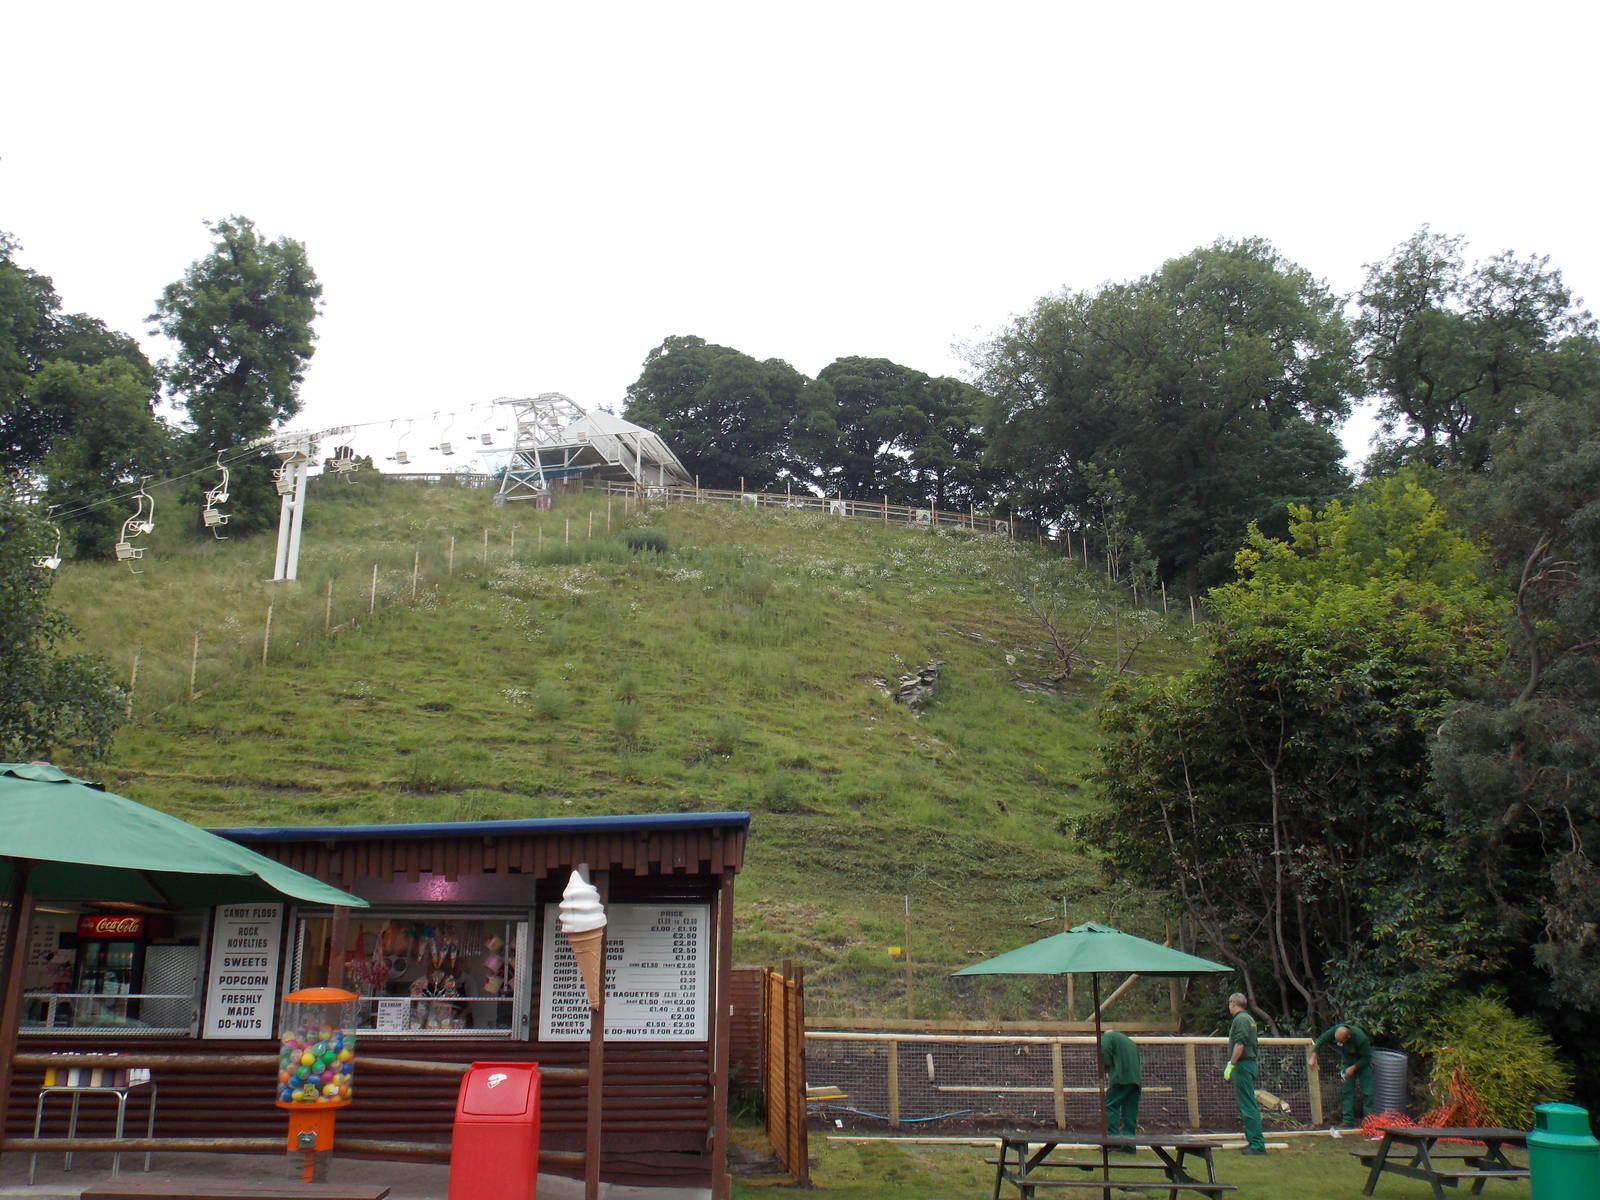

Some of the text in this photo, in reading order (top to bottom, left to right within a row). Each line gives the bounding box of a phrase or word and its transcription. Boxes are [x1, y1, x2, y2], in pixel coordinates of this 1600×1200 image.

[224, 908, 277, 917] CANDY FLOSS
[239, 928, 258, 936] ROCK
[227, 939, 267, 948] NOVELTIES
[224, 958, 267, 966] SWEETS
[219, 976, 268, 985] POPCORN
[221, 995, 262, 1004] FRESHLY
[227, 1007, 255, 1016] MADE
[218, 1020, 262, 1028] DO-NUTS
